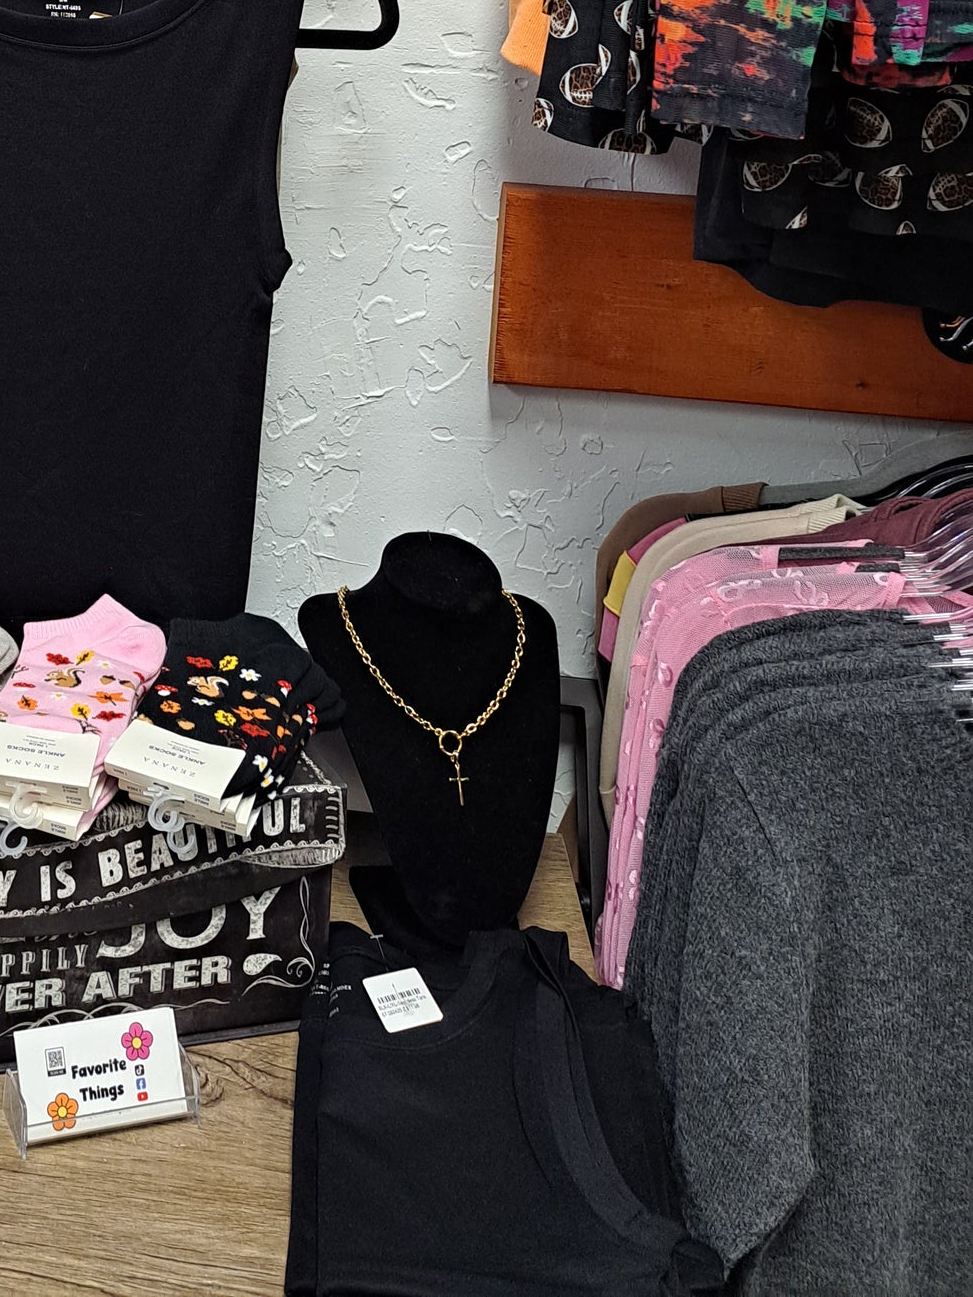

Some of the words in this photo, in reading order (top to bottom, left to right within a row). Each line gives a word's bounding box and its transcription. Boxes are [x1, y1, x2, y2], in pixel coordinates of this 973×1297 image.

[7, 745, 36, 753] SOCKS
[37, 750, 65, 758] ANKLE
[149, 745, 177, 756] SOCKS
[5, 758, 59, 771] ZENANA
[144, 756, 196, 777] ZENANA
[178, 754, 206, 765] ANKLE
[40, 860, 76, 902] IS
[81, 955, 232, 1002] AFTER
[71, 1058, 127, 1079] Favorite
[79, 1084, 124, 1102] Things
